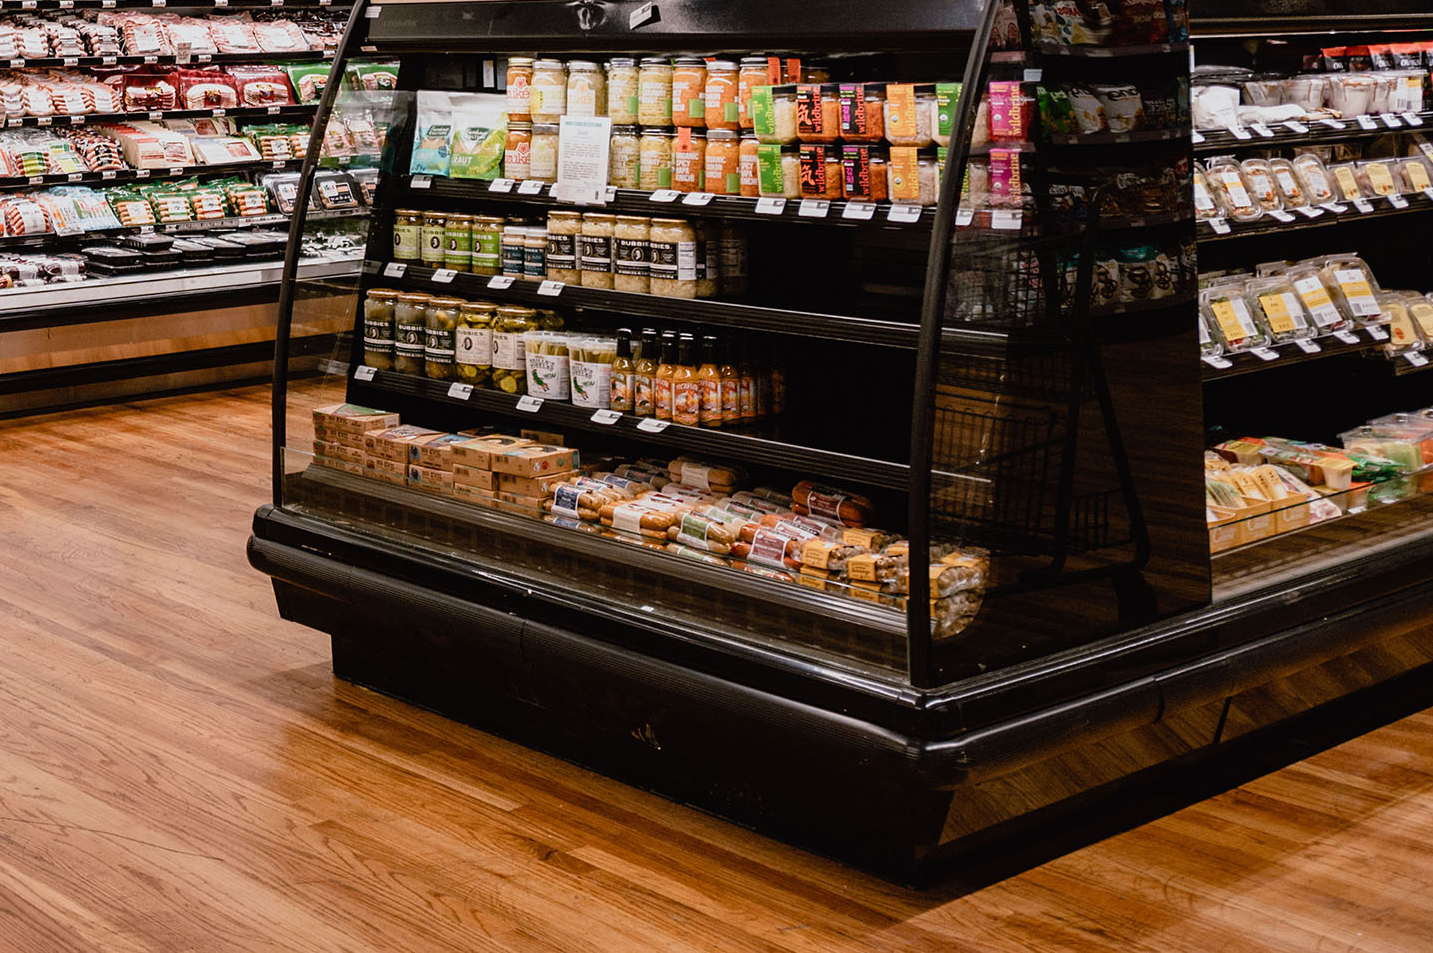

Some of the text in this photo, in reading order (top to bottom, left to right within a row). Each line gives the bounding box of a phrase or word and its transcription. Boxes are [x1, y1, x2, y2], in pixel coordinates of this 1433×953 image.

[811, 85, 822, 133] wildbrine
[855, 86, 866, 134] wildbrine
[1008, 85, 1021, 135] wildbrine
[815, 147, 826, 194] wildbrine
[858, 148, 870, 196] wildbrine
[908, 147, 919, 198] wildbrine
[398, 324, 423, 332] BUBBIE
